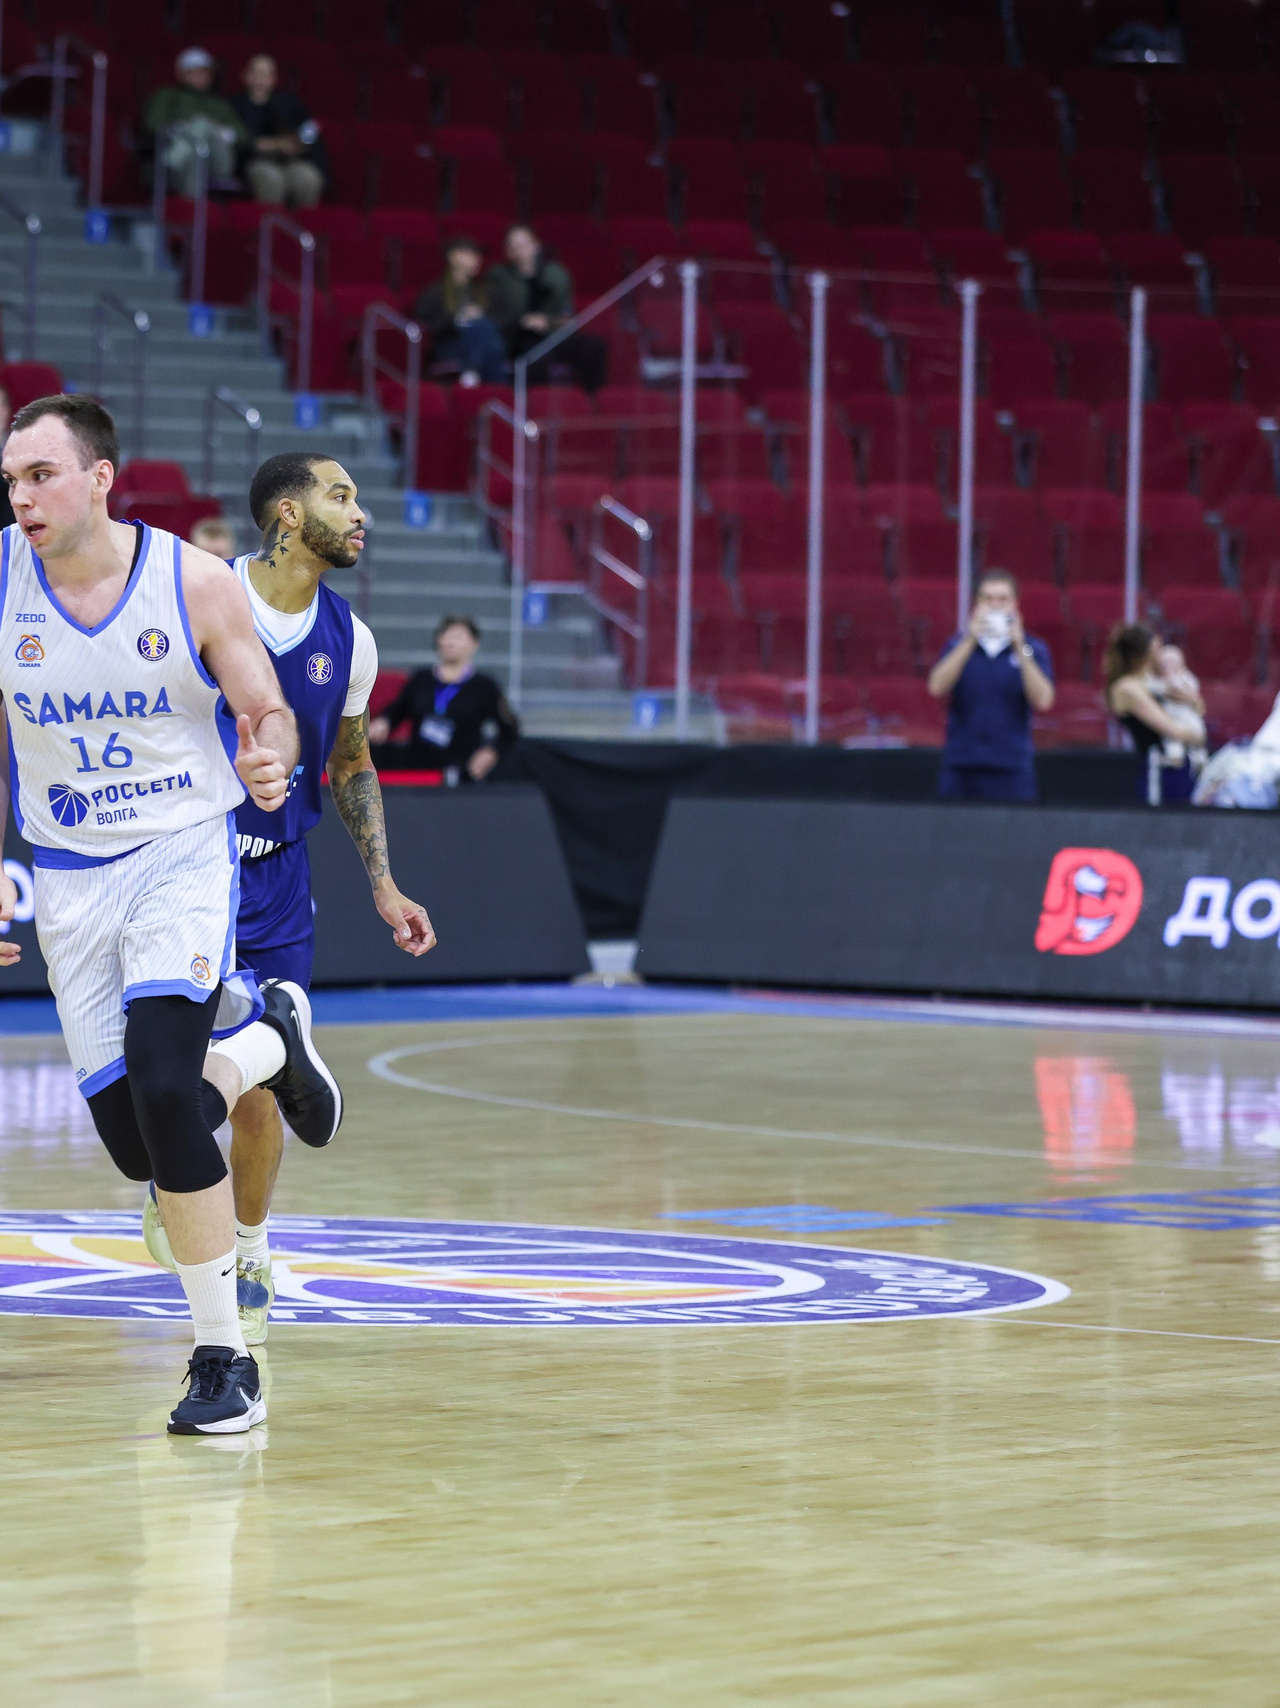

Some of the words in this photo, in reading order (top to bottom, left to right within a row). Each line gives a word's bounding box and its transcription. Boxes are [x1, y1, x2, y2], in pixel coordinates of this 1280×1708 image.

[15, 613, 46, 623] ZEDO
[13, 686, 173, 728] SAMARA
[70, 731, 134, 774] 16
[91, 771, 193, 808] РОССЕТИ
[96, 806, 139, 826] ВОЛГА
[1162, 875, 1280, 950] ДО
[459, 1298, 920, 1322] UNITED
